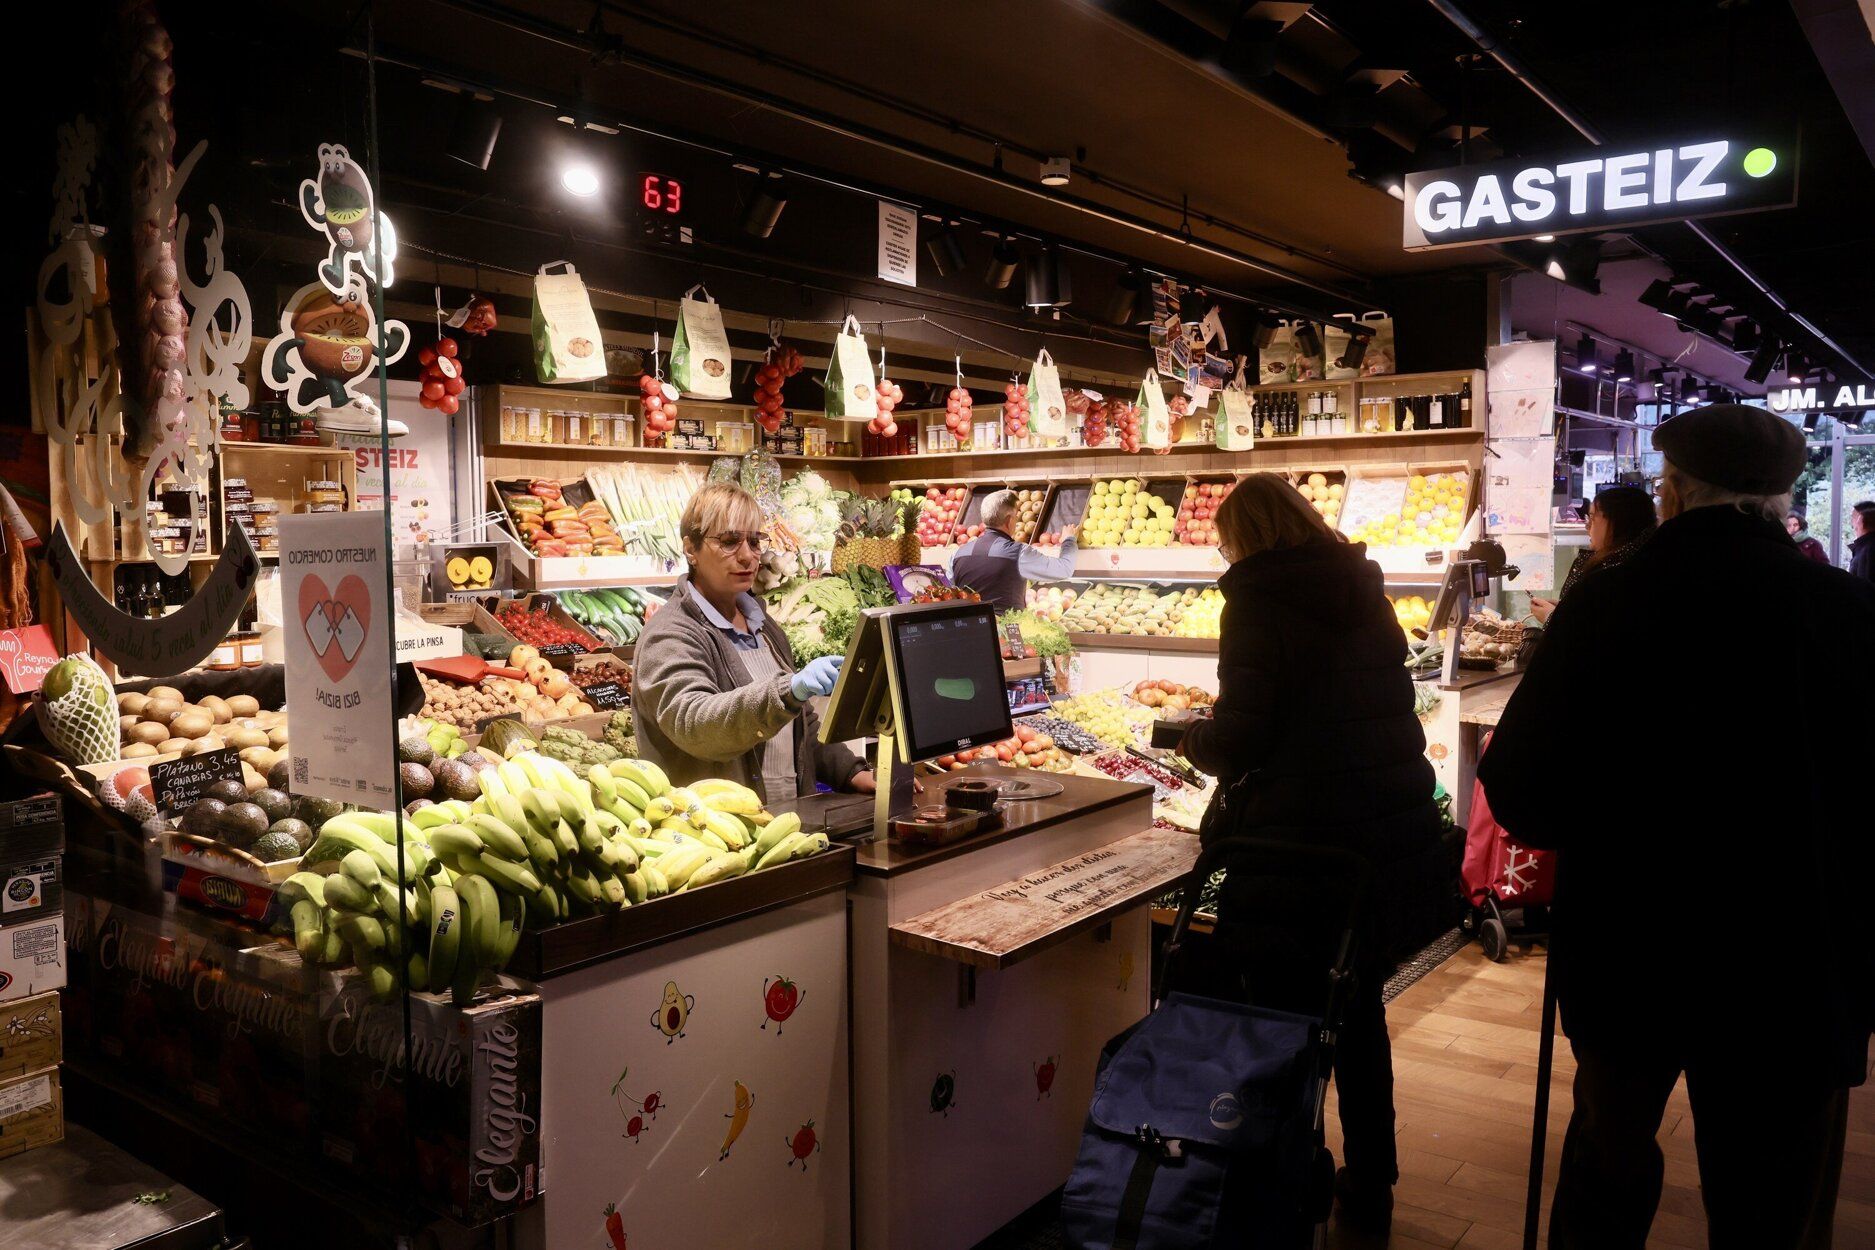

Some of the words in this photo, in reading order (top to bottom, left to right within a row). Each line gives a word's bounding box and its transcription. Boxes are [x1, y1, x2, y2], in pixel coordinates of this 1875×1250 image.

[645, 176, 681, 212] 63
[1414, 140, 1729, 233] GASTEIZ
[1773, 387, 1825, 411] JM.
[1833, 384, 1875, 408] AL
[355, 447, 418, 468] STEIZ
[112, 630, 145, 662] salud
[151, 629, 162, 662] 5
[417, 638, 426, 648] LA
[426, 637, 444, 647] PINSA
[981, 889, 1028, 902] Voy
[1062, 862, 1085, 873] dos
[1044, 881, 1088, 904] porque
[328, 996, 462, 1090] Elegante
[474, 1022, 536, 1202] Elegante
